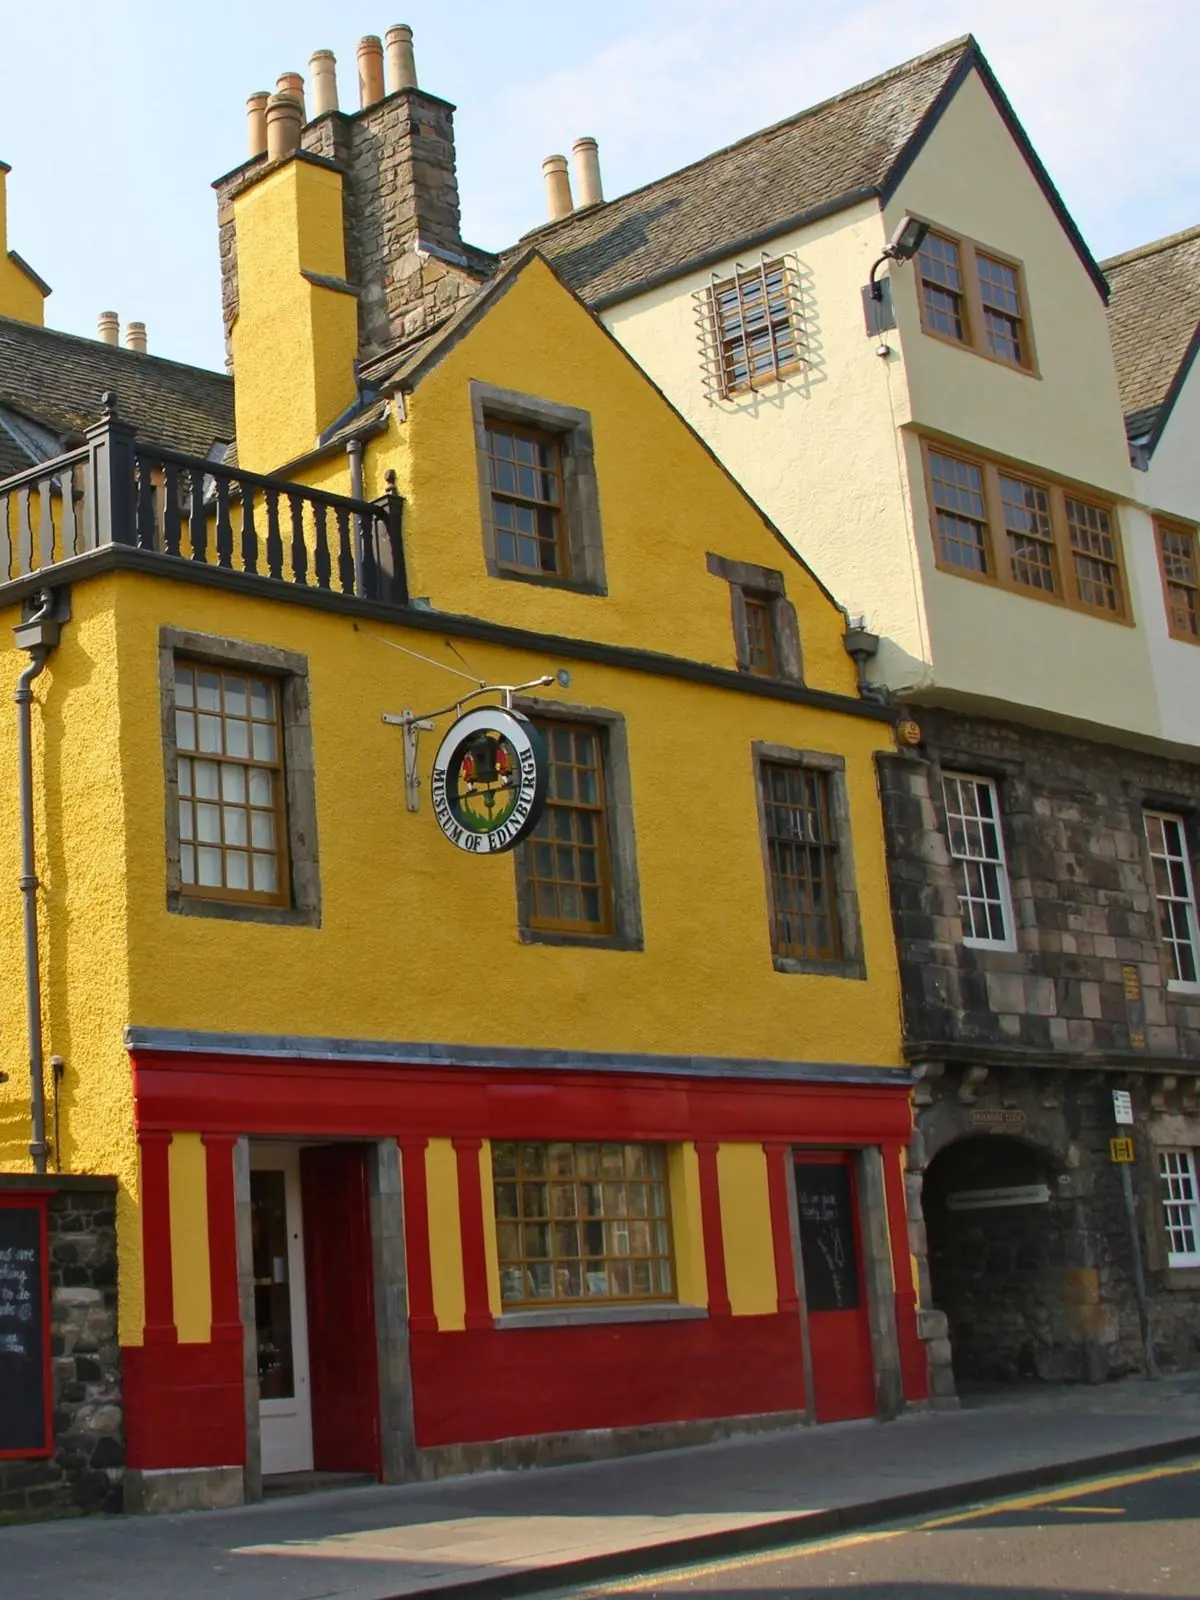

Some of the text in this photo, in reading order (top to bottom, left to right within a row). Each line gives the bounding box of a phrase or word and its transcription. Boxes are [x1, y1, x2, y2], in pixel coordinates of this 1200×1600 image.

[433, 747, 535, 851] MUSEUM OF EDINBURGH
[15, 1248, 36, 1262] are
